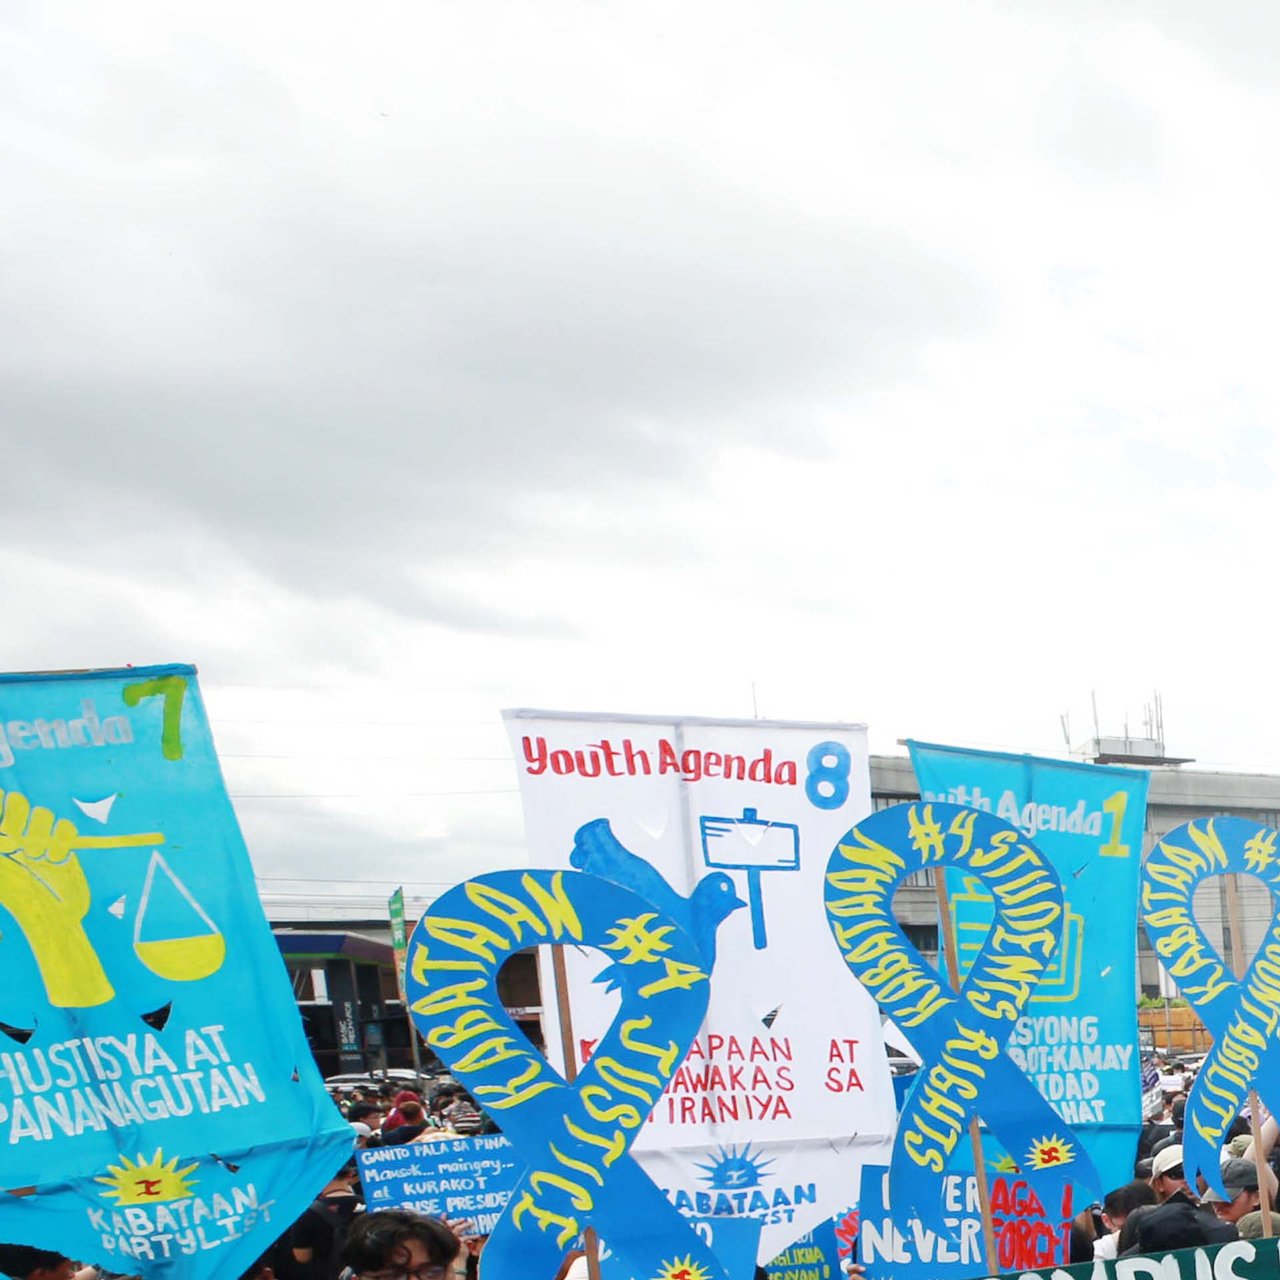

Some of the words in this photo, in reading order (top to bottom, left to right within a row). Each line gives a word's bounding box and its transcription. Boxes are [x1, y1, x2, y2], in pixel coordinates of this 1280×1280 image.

[122, 675, 187, 761] 7
[521, 736, 651, 780] Youth
[658, 736, 797, 787] Agenda
[804, 740, 853, 811] 8
[907, 803, 979, 865] #4
[997, 789, 1101, 838] Agenda
[1098, 791, 1130, 858] 1
[825, 826, 962, 1028] KABATAAN
[968, 829, 1058, 1022] STUDENTS
[1141, 816, 1241, 1007] KABATAAN
[184, 1025, 231, 1072] AT
[411, 870, 583, 1111] KABATAAN
[512, 1013, 680, 1251] JUSTICE
[824, 1066, 865, 1094] SA
[828, 1038, 859, 1063] AT
[903, 1017, 999, 1174] RIGHTS
[361, 1148, 409, 1166] GANITO
[415, 1143, 447, 1157] PALA
[452, 1138, 470, 1151] SA
[403, 1176, 489, 1196] KURAKOT
[87, 1183, 259, 1236] KABATAAN
